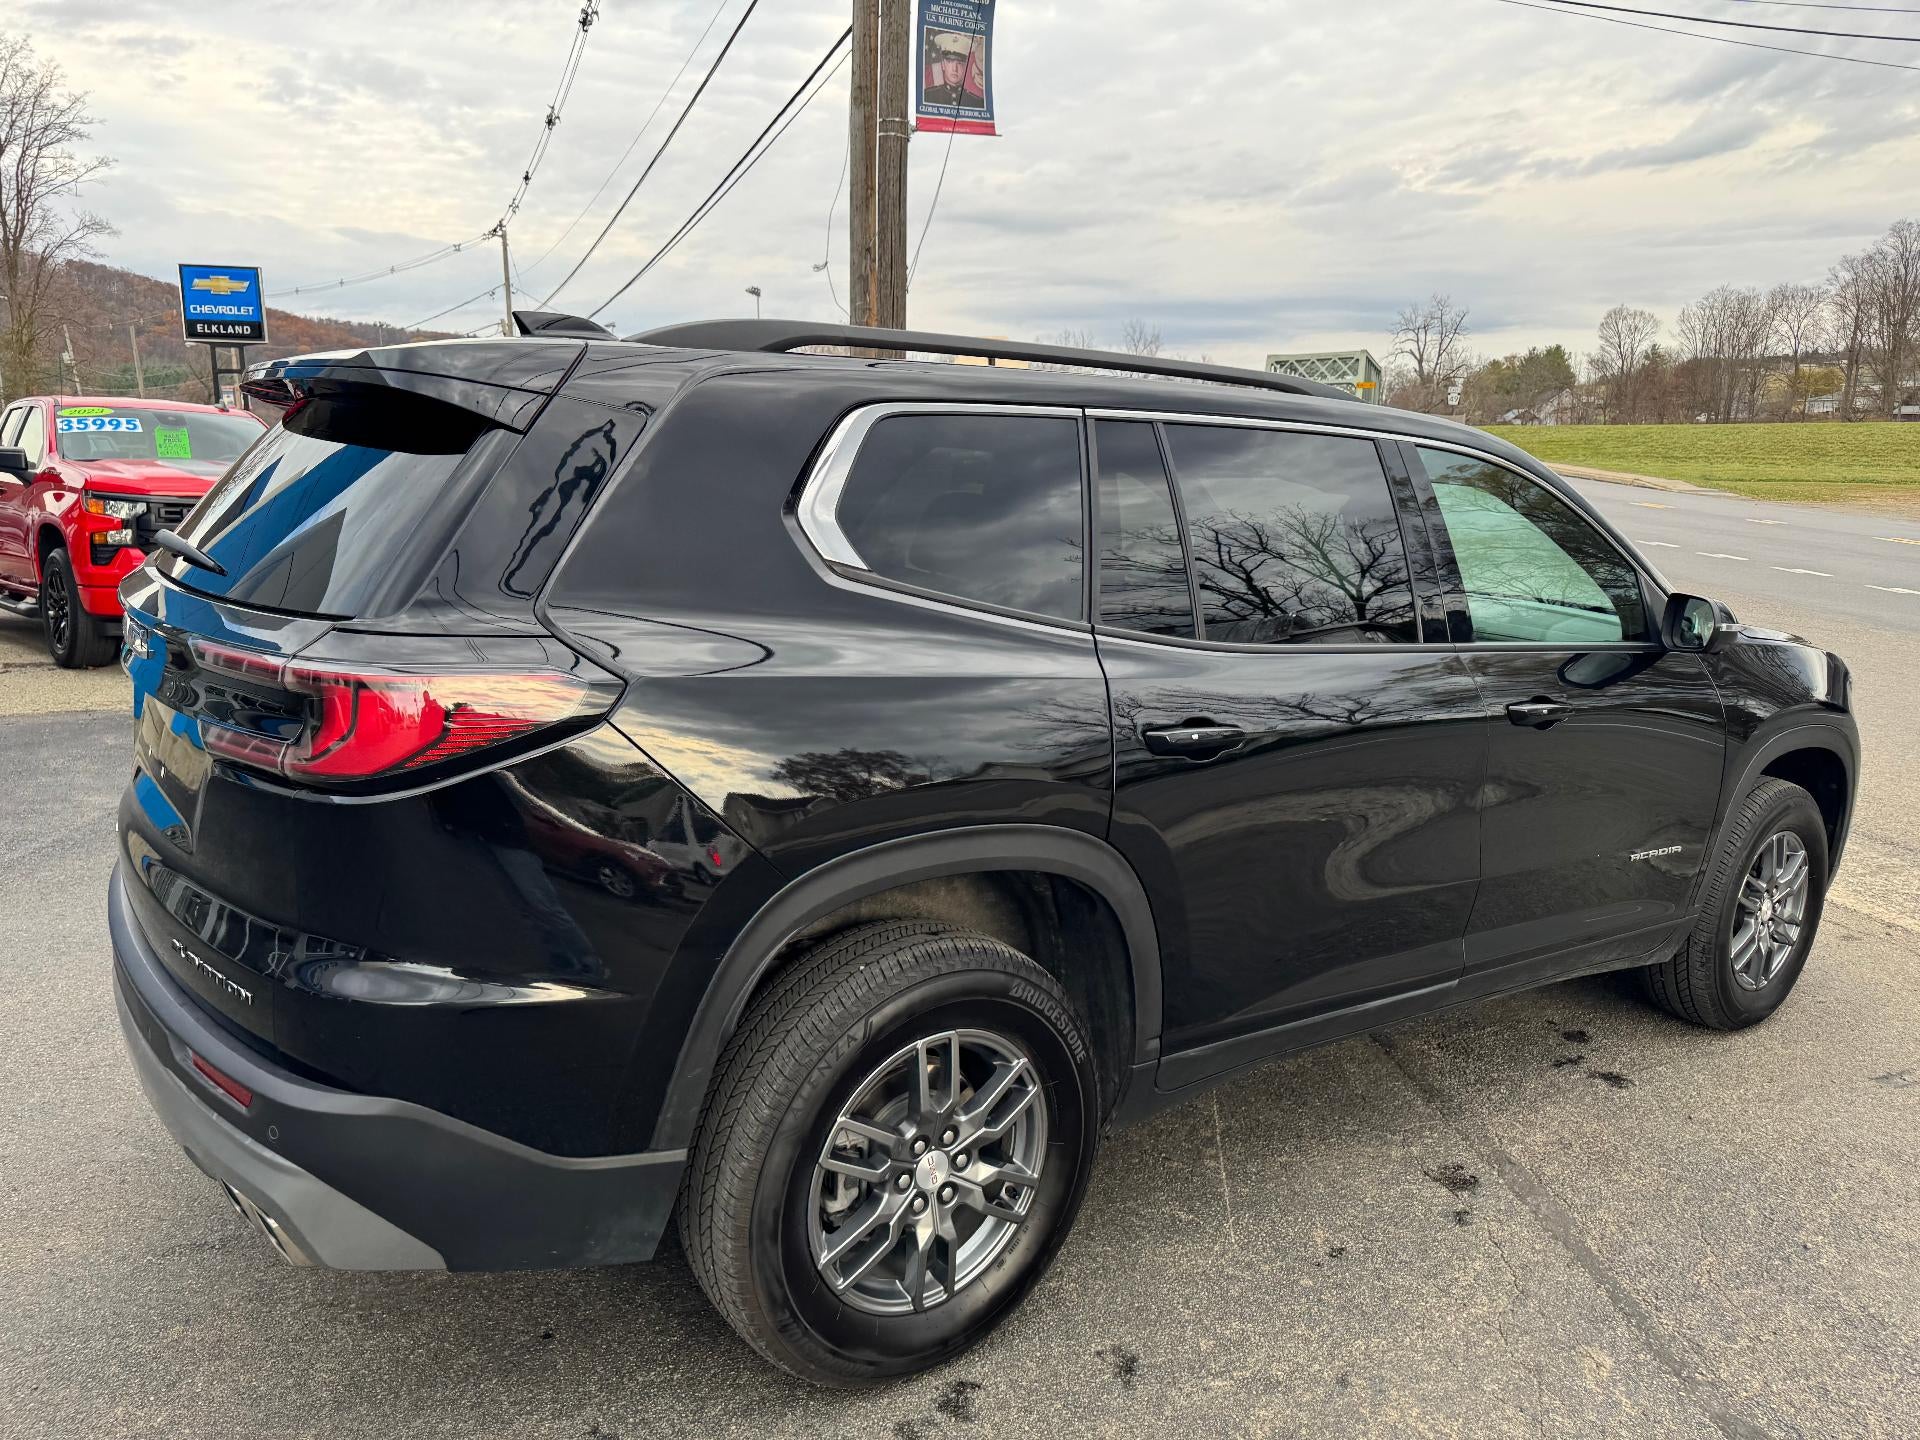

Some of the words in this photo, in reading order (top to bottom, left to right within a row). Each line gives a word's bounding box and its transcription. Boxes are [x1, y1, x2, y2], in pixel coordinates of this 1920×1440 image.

[930, 4, 960, 16] MICHAEL
[939, 15, 963, 27] MARINE
[964, 21, 986, 31] CORPS
[920, 105, 939, 114] GLOBAL
[189, 304, 254, 315] CHEVROLET
[196, 323, 251, 335] ELKLAND
[59, 418, 138, 432] 35995
[1630, 845, 1682, 862] ACADIA
[1009, 981, 1087, 1064] BRIDGESTONE
